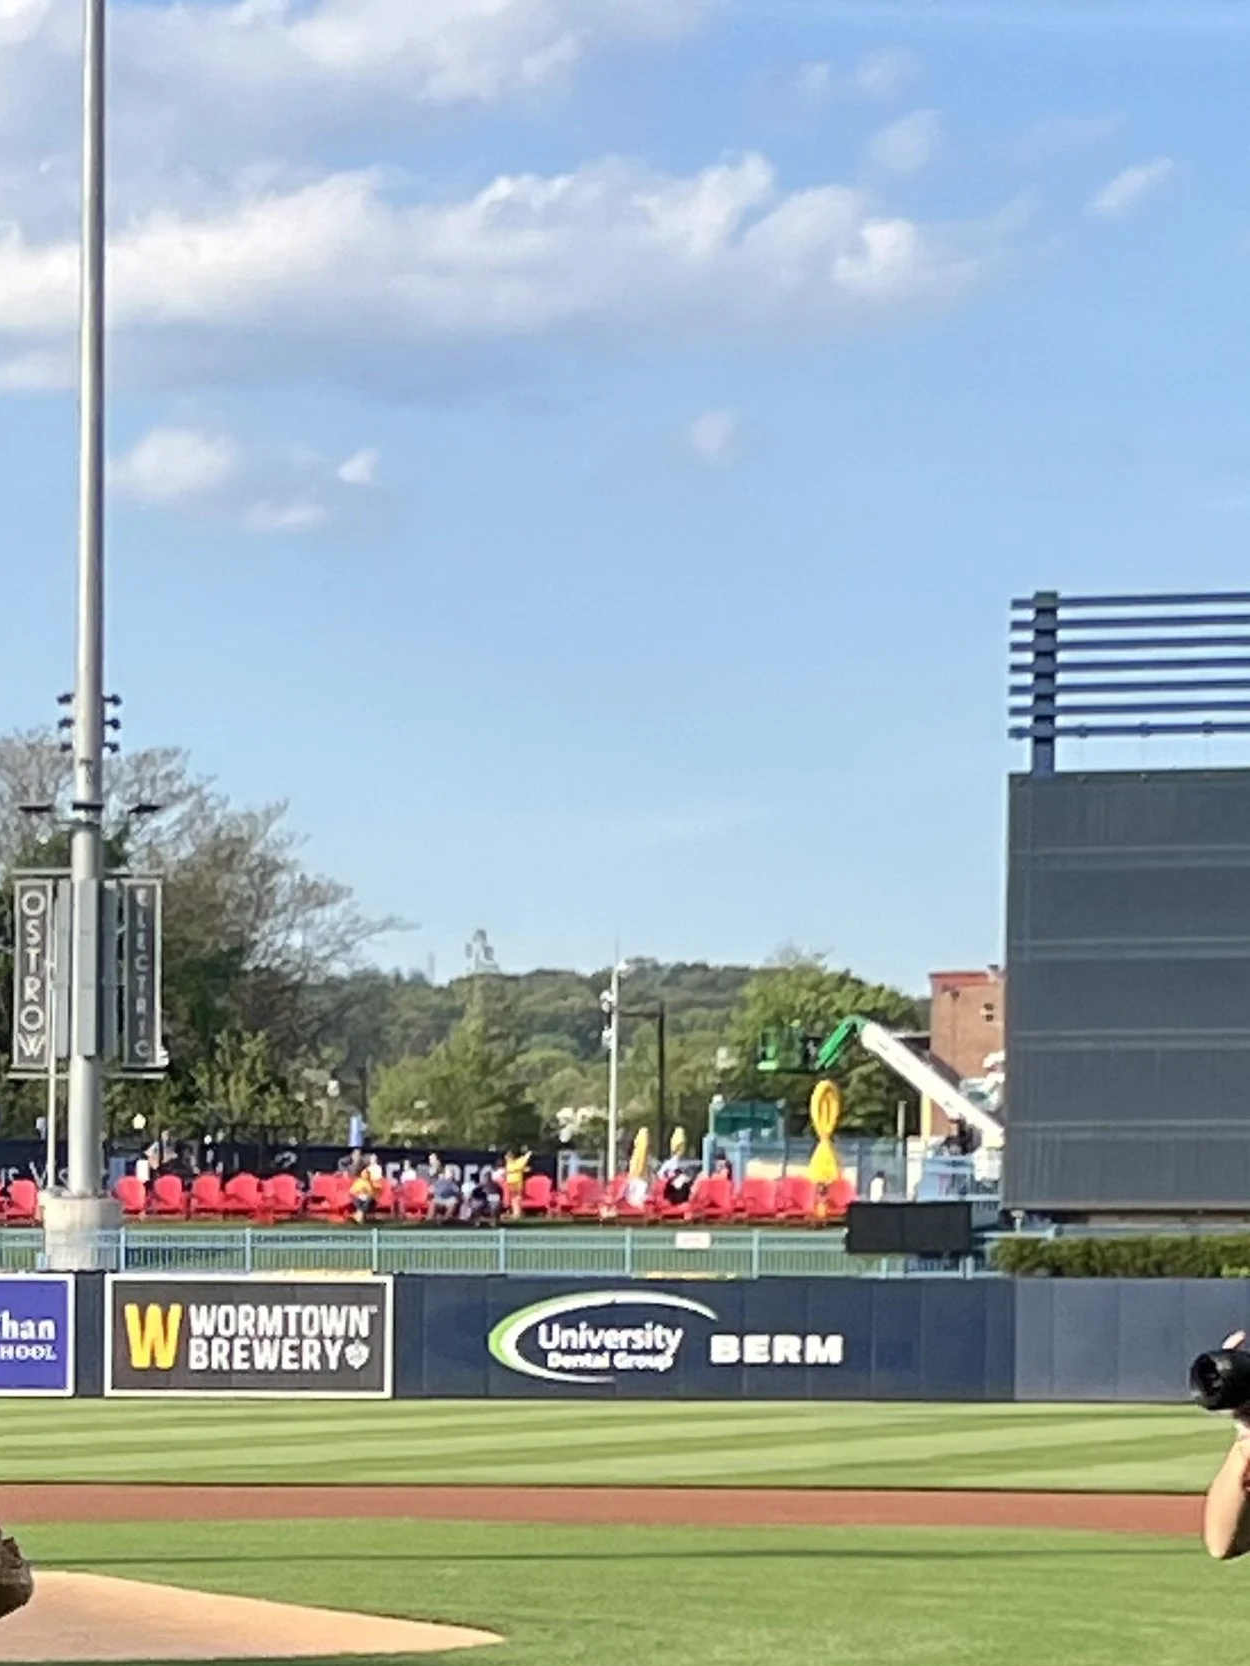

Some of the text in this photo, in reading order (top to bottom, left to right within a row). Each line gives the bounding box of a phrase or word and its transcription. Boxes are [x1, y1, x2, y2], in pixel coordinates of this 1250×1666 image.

[17, 889, 47, 1058] OSTROW
[134, 887, 151, 1058] ELECTRIC
[124, 1303, 183, 1370] W
[188, 1304, 371, 1338] WORMTOWN
[188, 1337, 344, 1371] BREWERY
[537, 1321, 684, 1358] University
[710, 1333, 844, 1365] BERM
[547, 1350, 674, 1372] Dental Group
